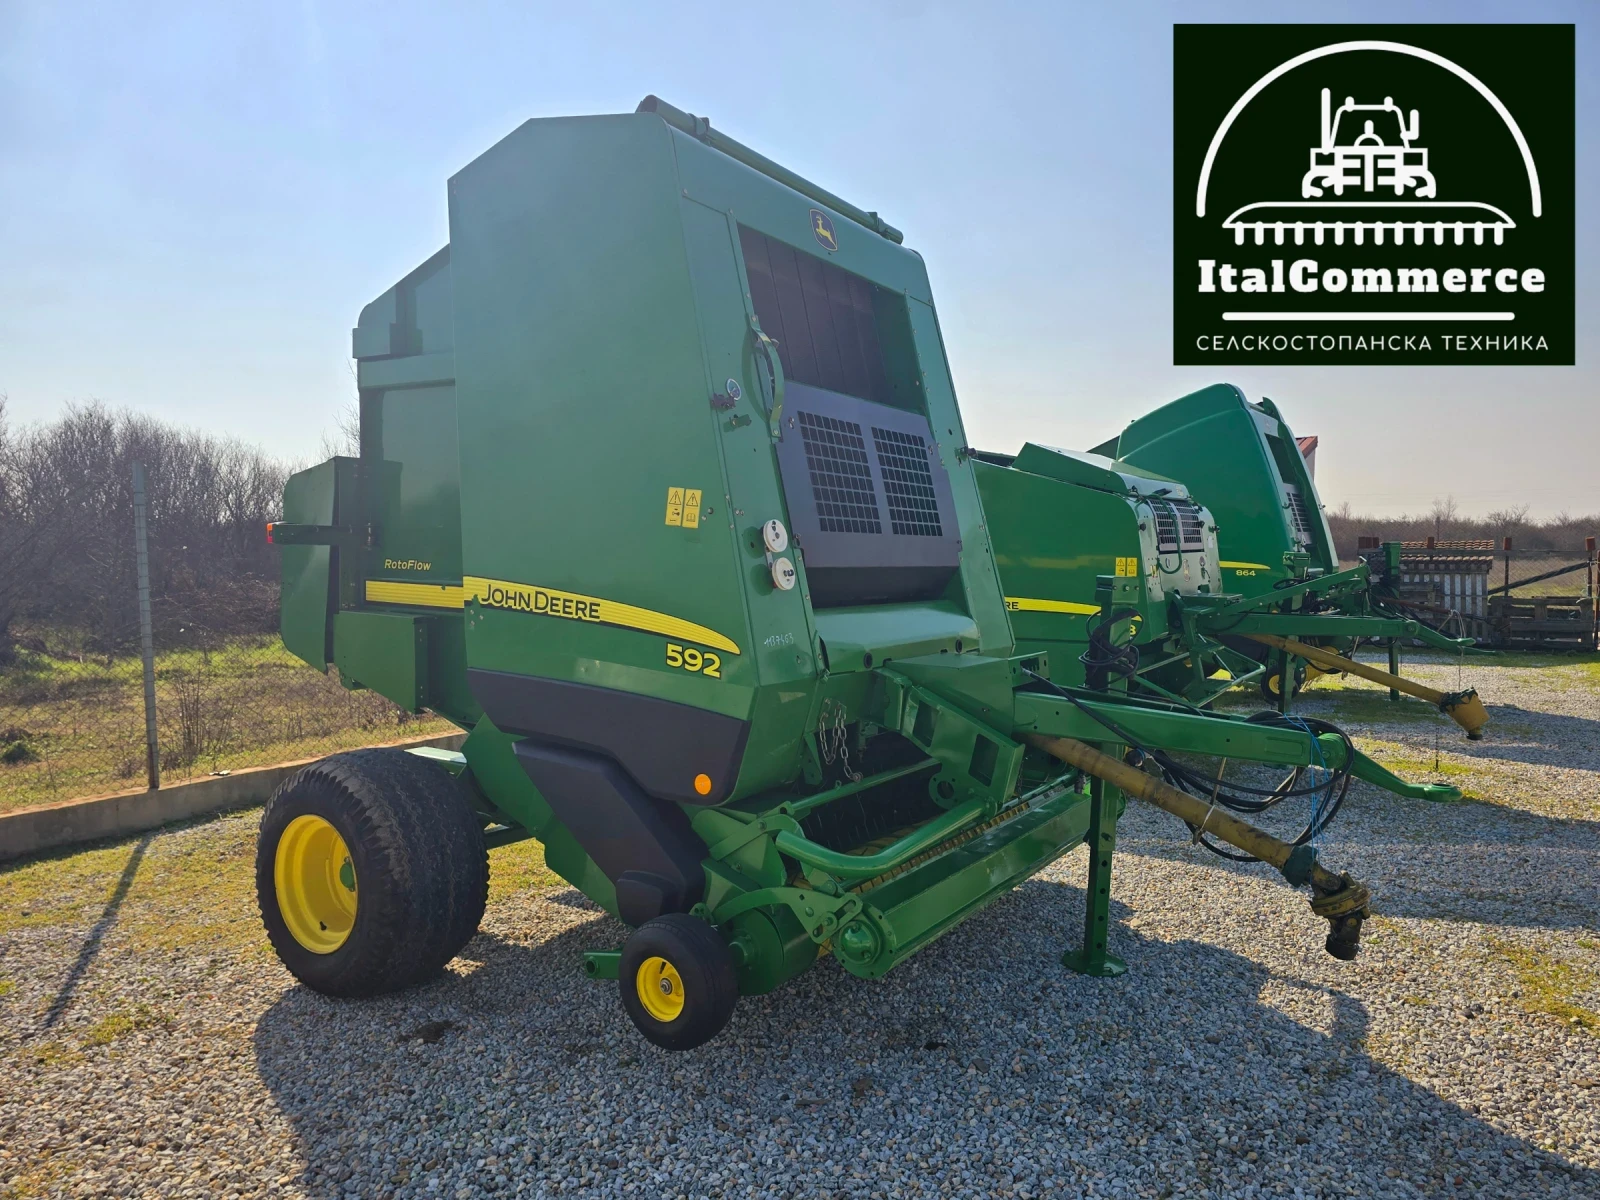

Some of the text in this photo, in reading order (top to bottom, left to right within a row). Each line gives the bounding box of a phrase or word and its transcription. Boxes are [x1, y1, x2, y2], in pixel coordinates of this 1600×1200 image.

[384, 558, 432, 571] RotoFlow
[1235, 569, 1257, 577] 864
[665, 643, 721, 678] 592
